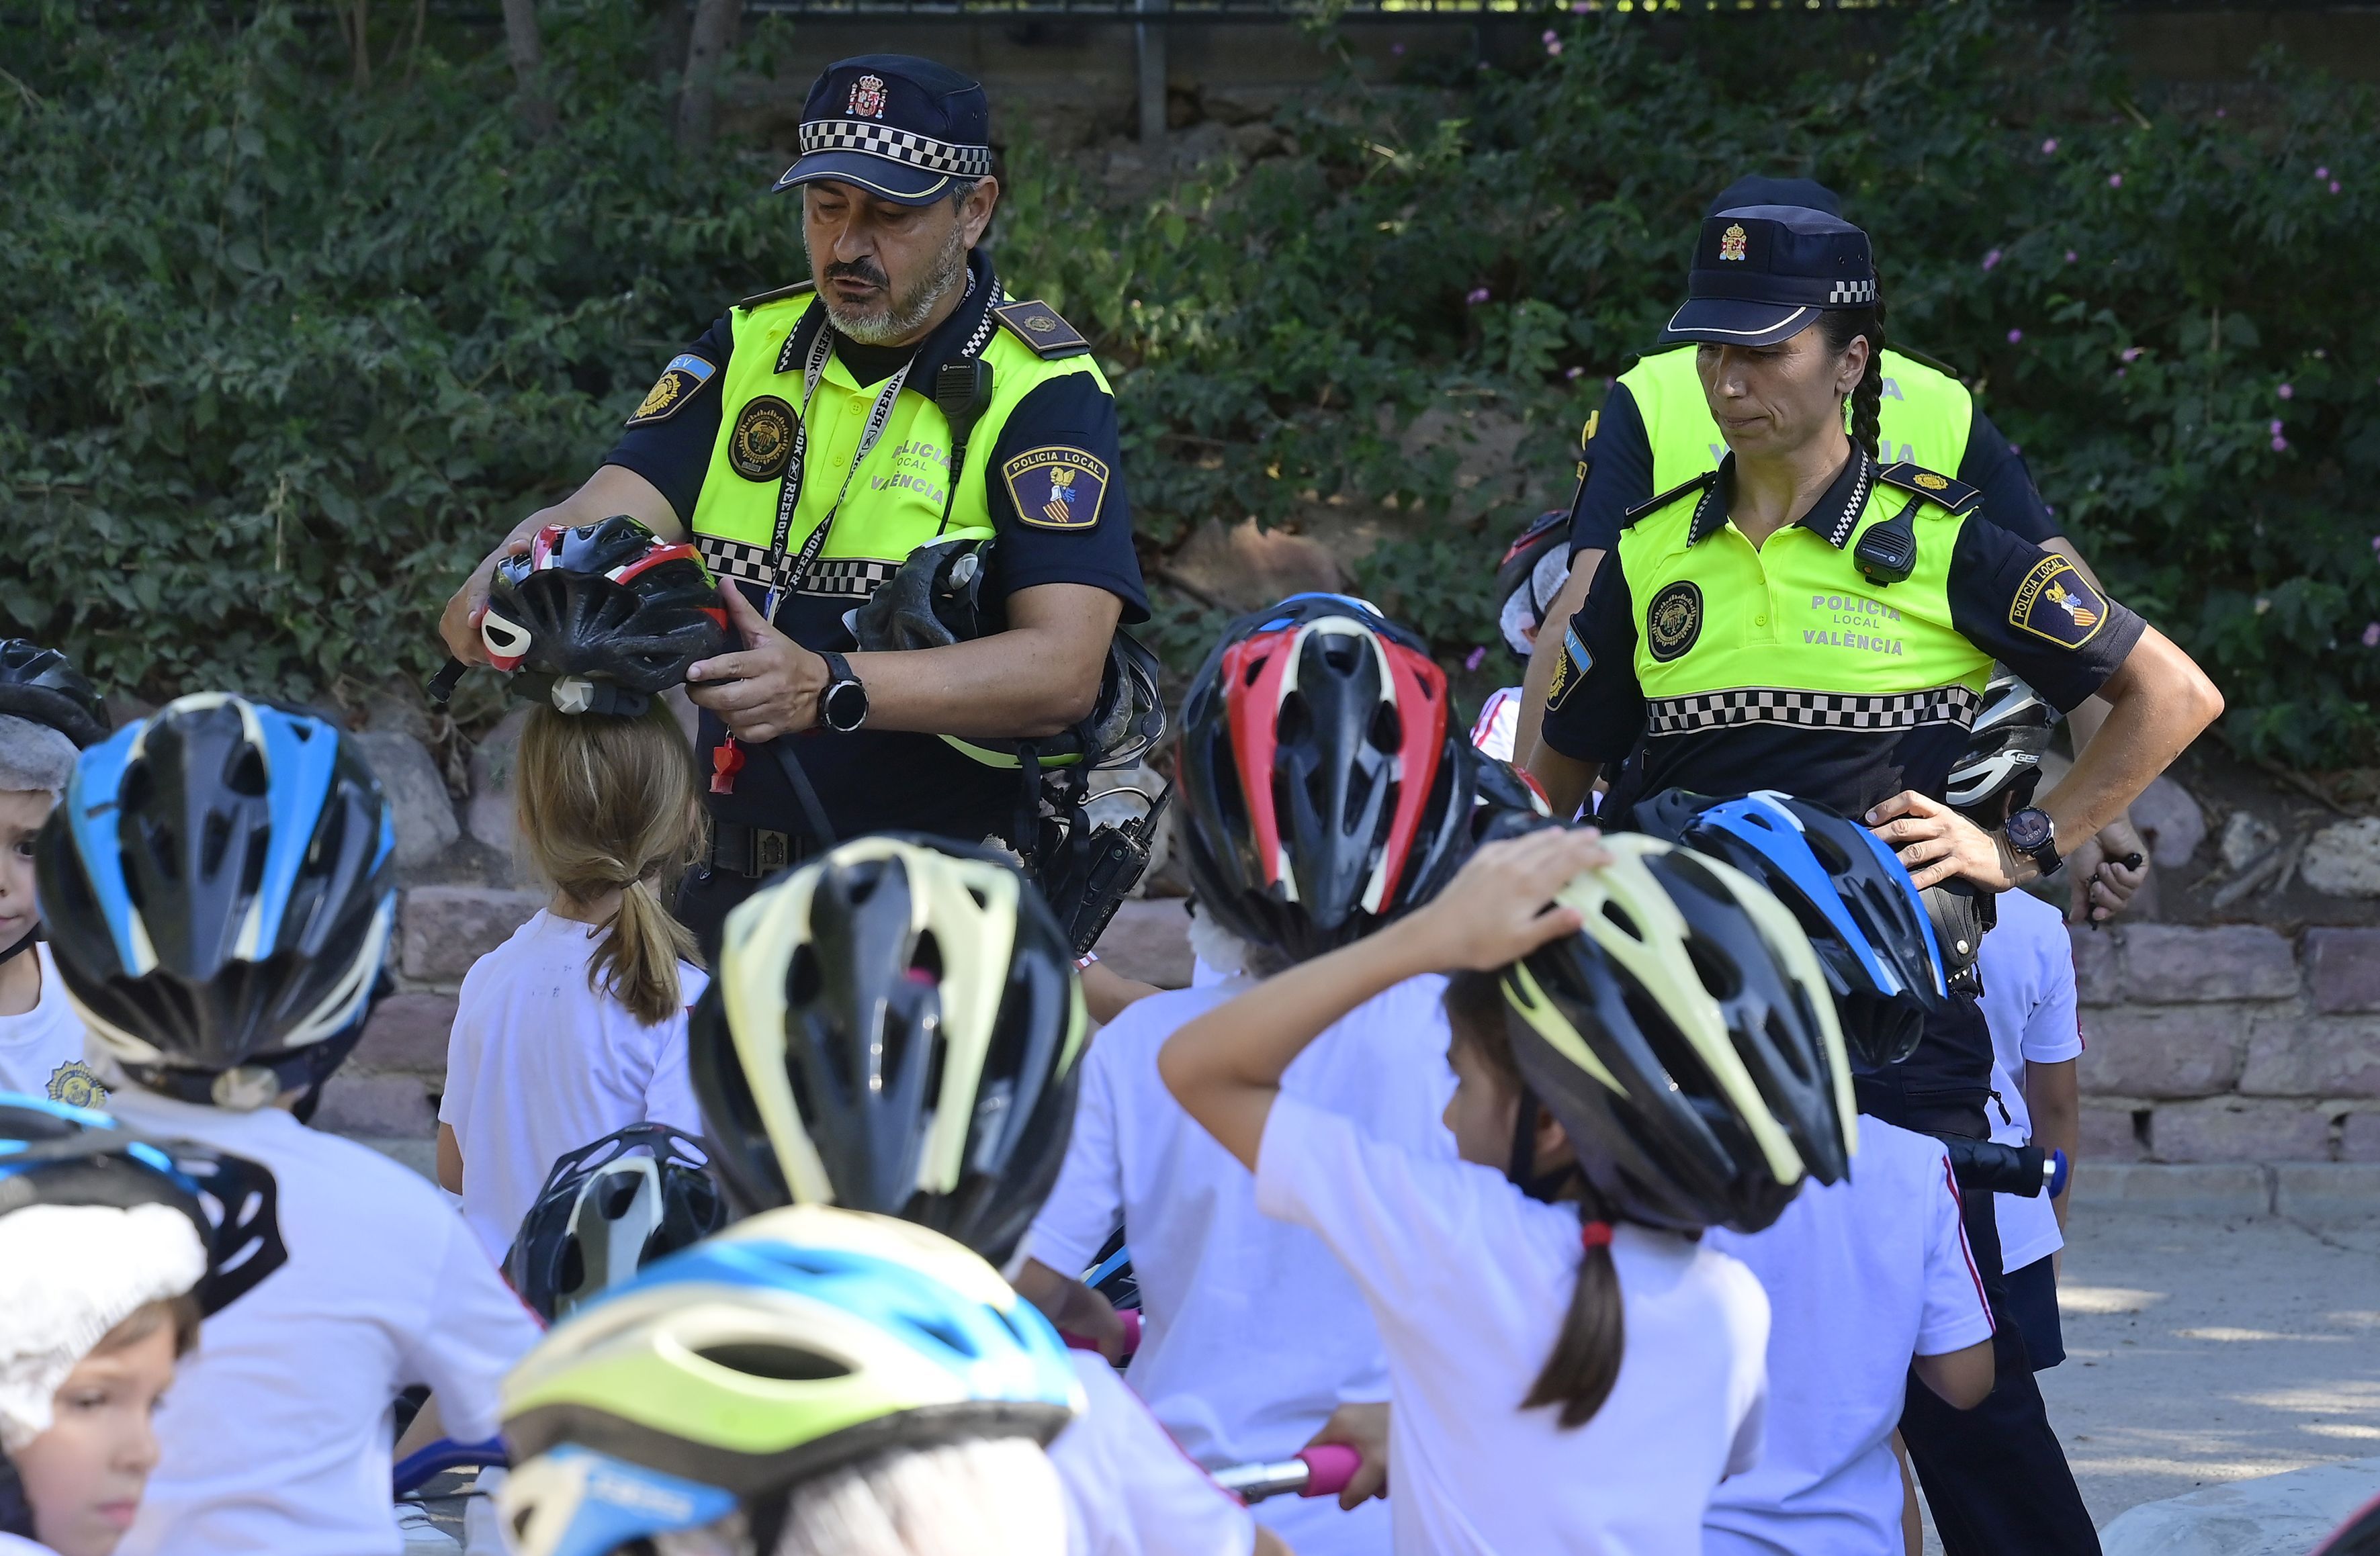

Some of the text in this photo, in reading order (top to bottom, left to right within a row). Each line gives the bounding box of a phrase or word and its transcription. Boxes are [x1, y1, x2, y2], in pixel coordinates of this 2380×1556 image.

[897, 457, 927, 471] OCAL
[1012, 452, 1100, 474] POLICIA LOCAL
[775, 482, 797, 540] REEBOK
[789, 530, 823, 586] REEBOK
[2014, 559, 2064, 618] POLICIA LOCAL
[1811, 596, 1901, 622] POLICIA
[1833, 614, 1880, 629] LOCAL
[1803, 630, 1902, 656] VALÈNCIA
[2025, 828, 2042, 841] 10:57
